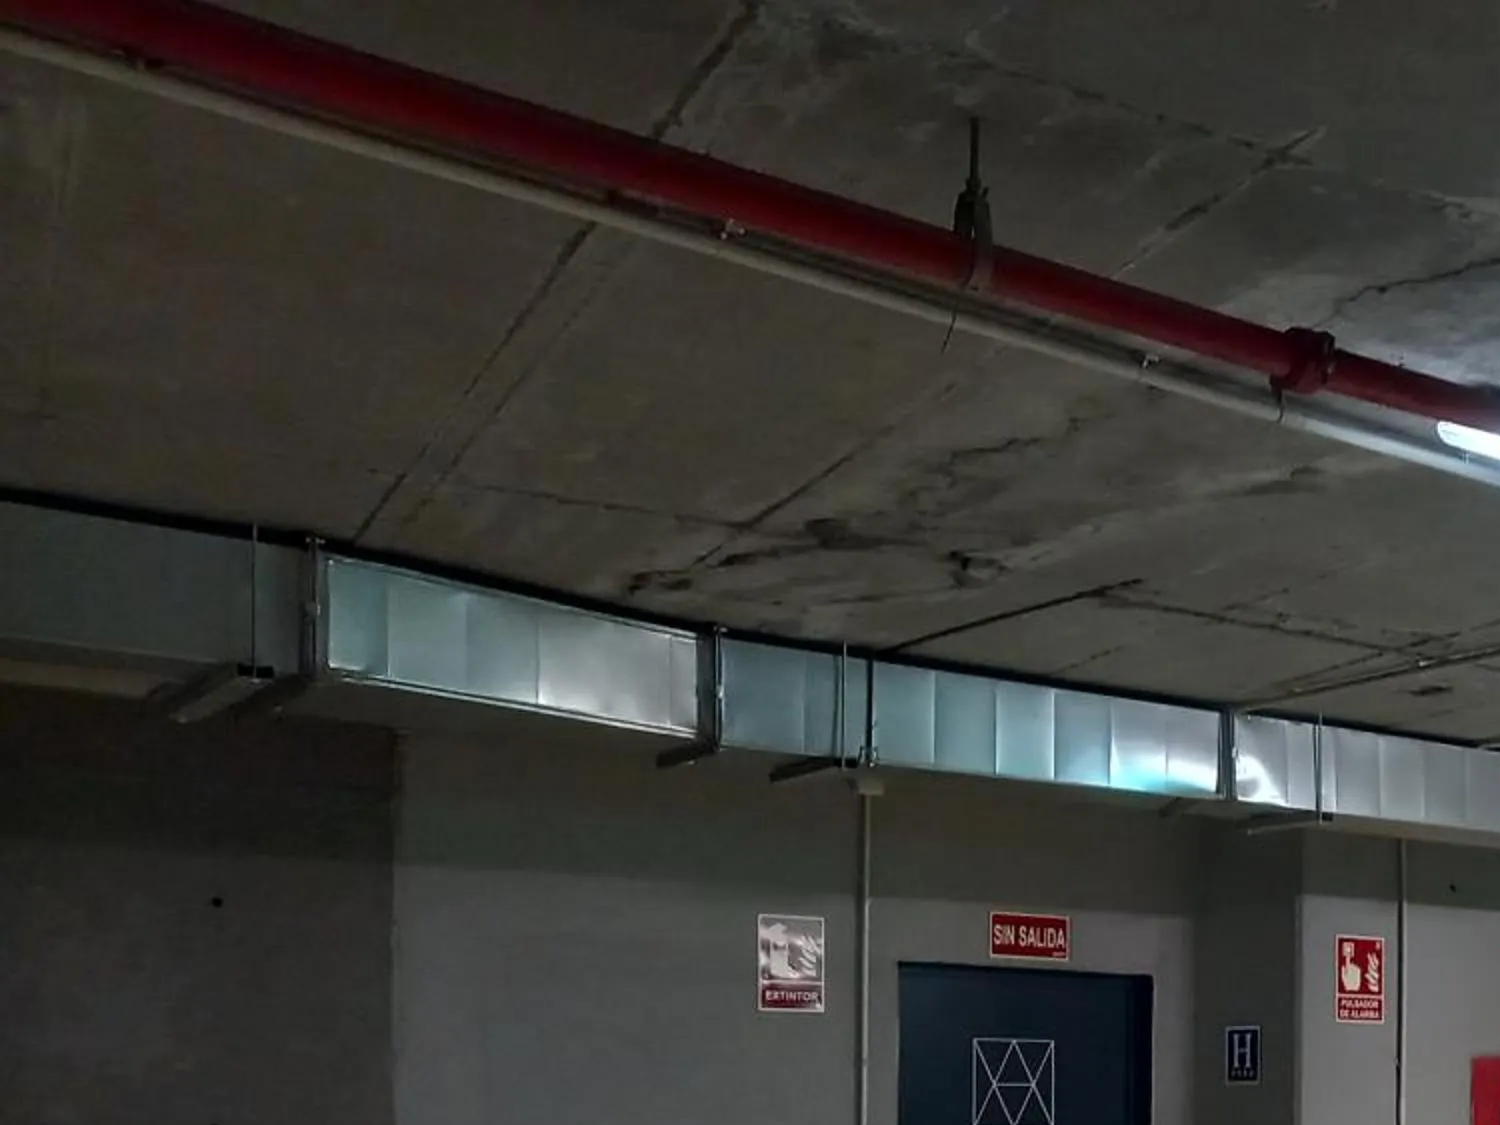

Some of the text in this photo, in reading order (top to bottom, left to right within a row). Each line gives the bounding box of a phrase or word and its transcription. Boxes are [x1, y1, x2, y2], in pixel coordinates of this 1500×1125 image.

[993, 923, 1066, 949] SIN SALIDA
[765, 989, 819, 1001] EXTINTOR
[1340, 999, 1379, 1009] PULSADOR
